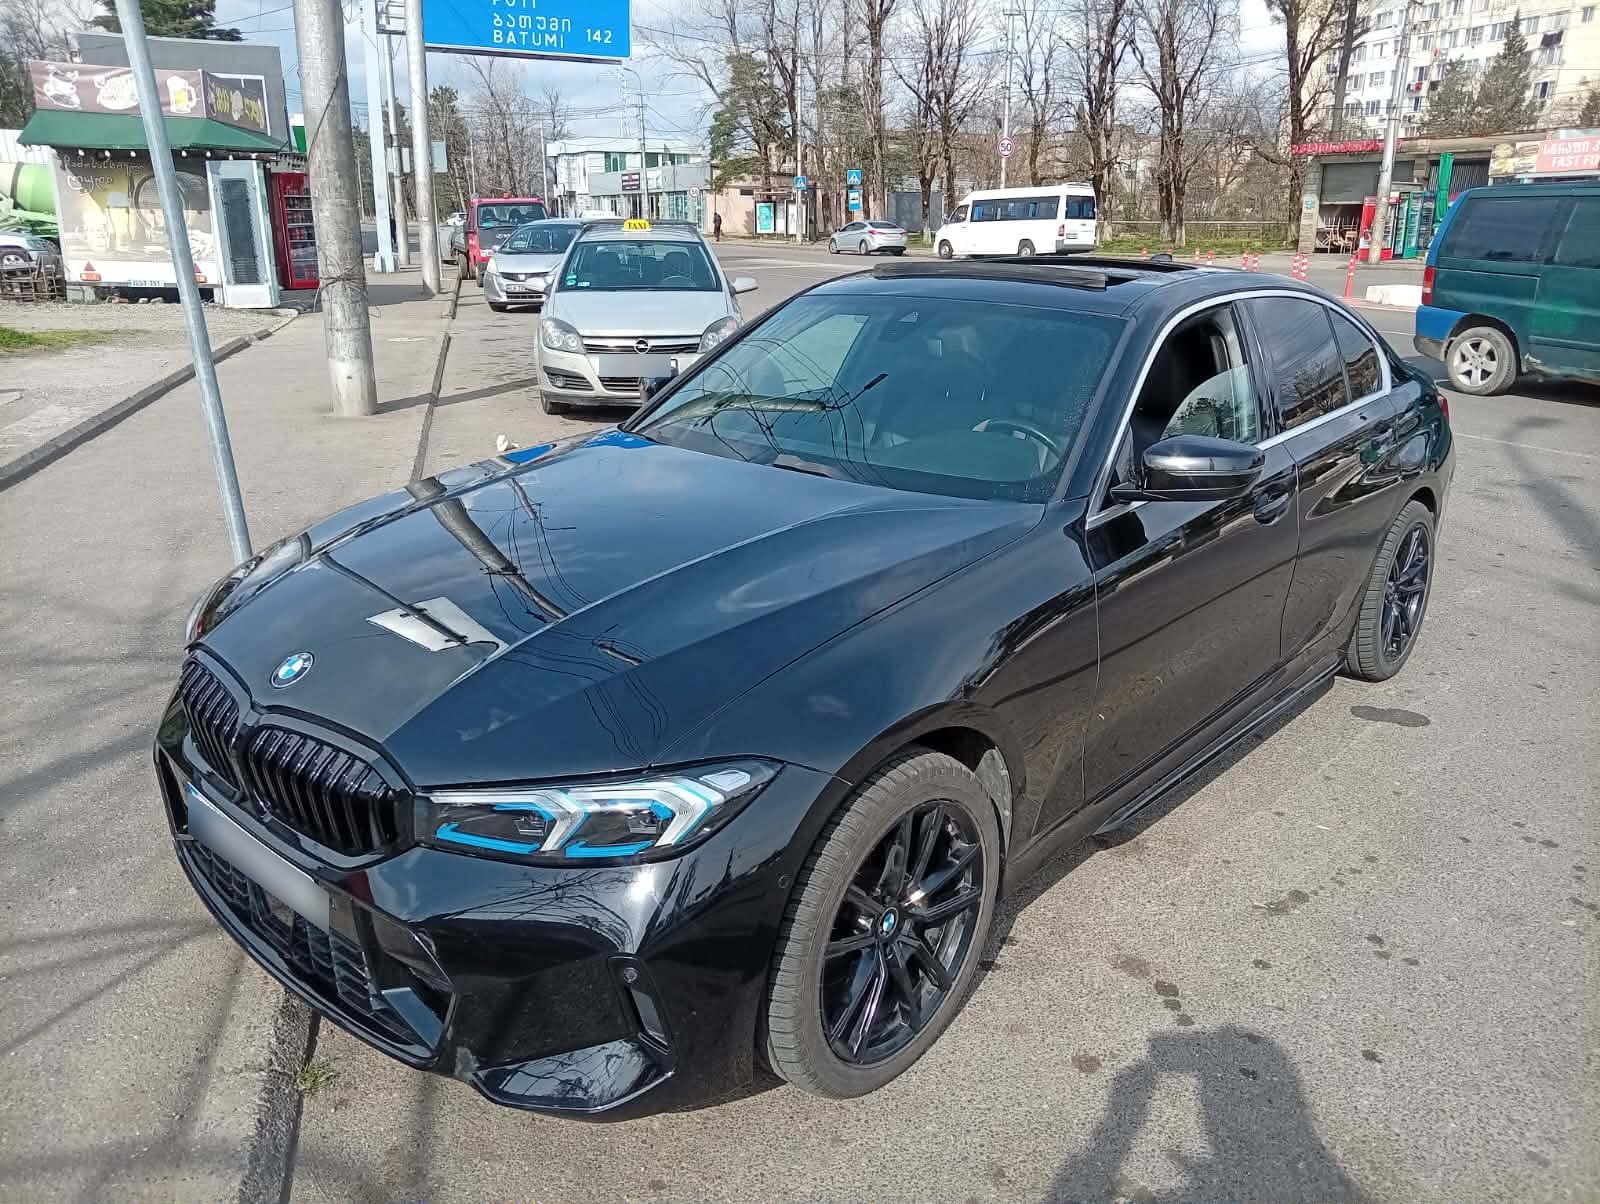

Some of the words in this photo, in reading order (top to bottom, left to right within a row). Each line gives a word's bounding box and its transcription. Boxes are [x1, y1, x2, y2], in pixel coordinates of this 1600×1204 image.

[493, 12, 571, 32] ბათუმი
[493, 30, 564, 48] BATUMI
[586, 28, 613, 44] 142
[1000, 142, 1012, 152] 50
[1552, 155, 1578, 168] FAST
[627, 221, 647, 230] TAXI
